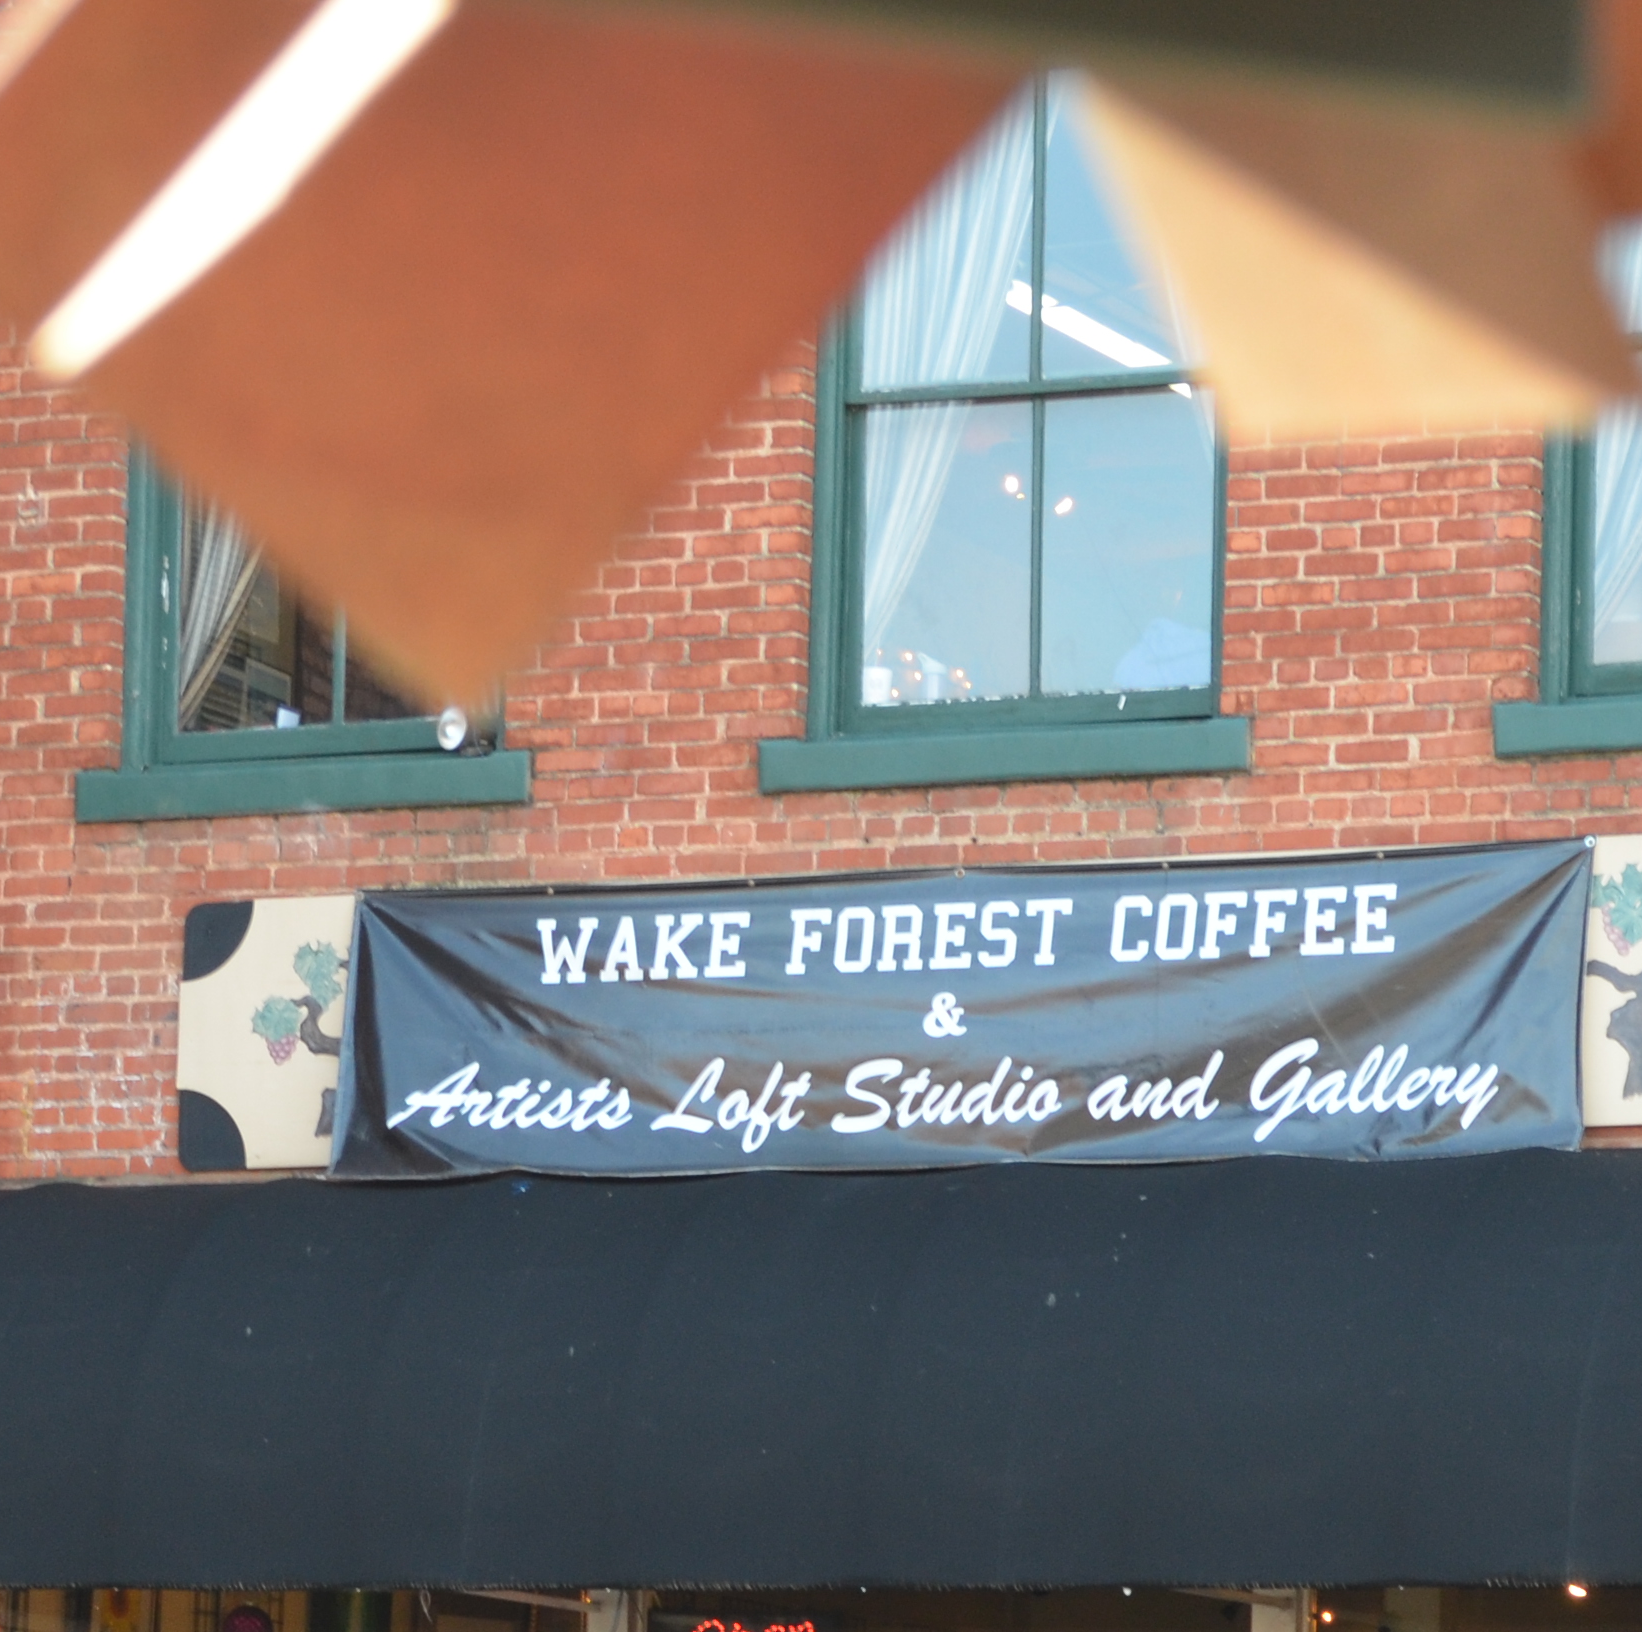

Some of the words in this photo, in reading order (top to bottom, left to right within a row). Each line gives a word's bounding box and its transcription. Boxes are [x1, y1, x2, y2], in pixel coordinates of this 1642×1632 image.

[536, 911, 751, 985] WAKE
[784, 898, 1074, 976] FOREST
[1109, 883, 1398, 963] COFFEE
[922, 991, 968, 1038] &
[386, 1061, 634, 1132] Artists
[650, 1056, 813, 1154] Loft
[830, 1055, 1062, 1134] Studio
[1086, 1049, 1225, 1122] and
[1248, 1037, 1499, 1143] Gallery
